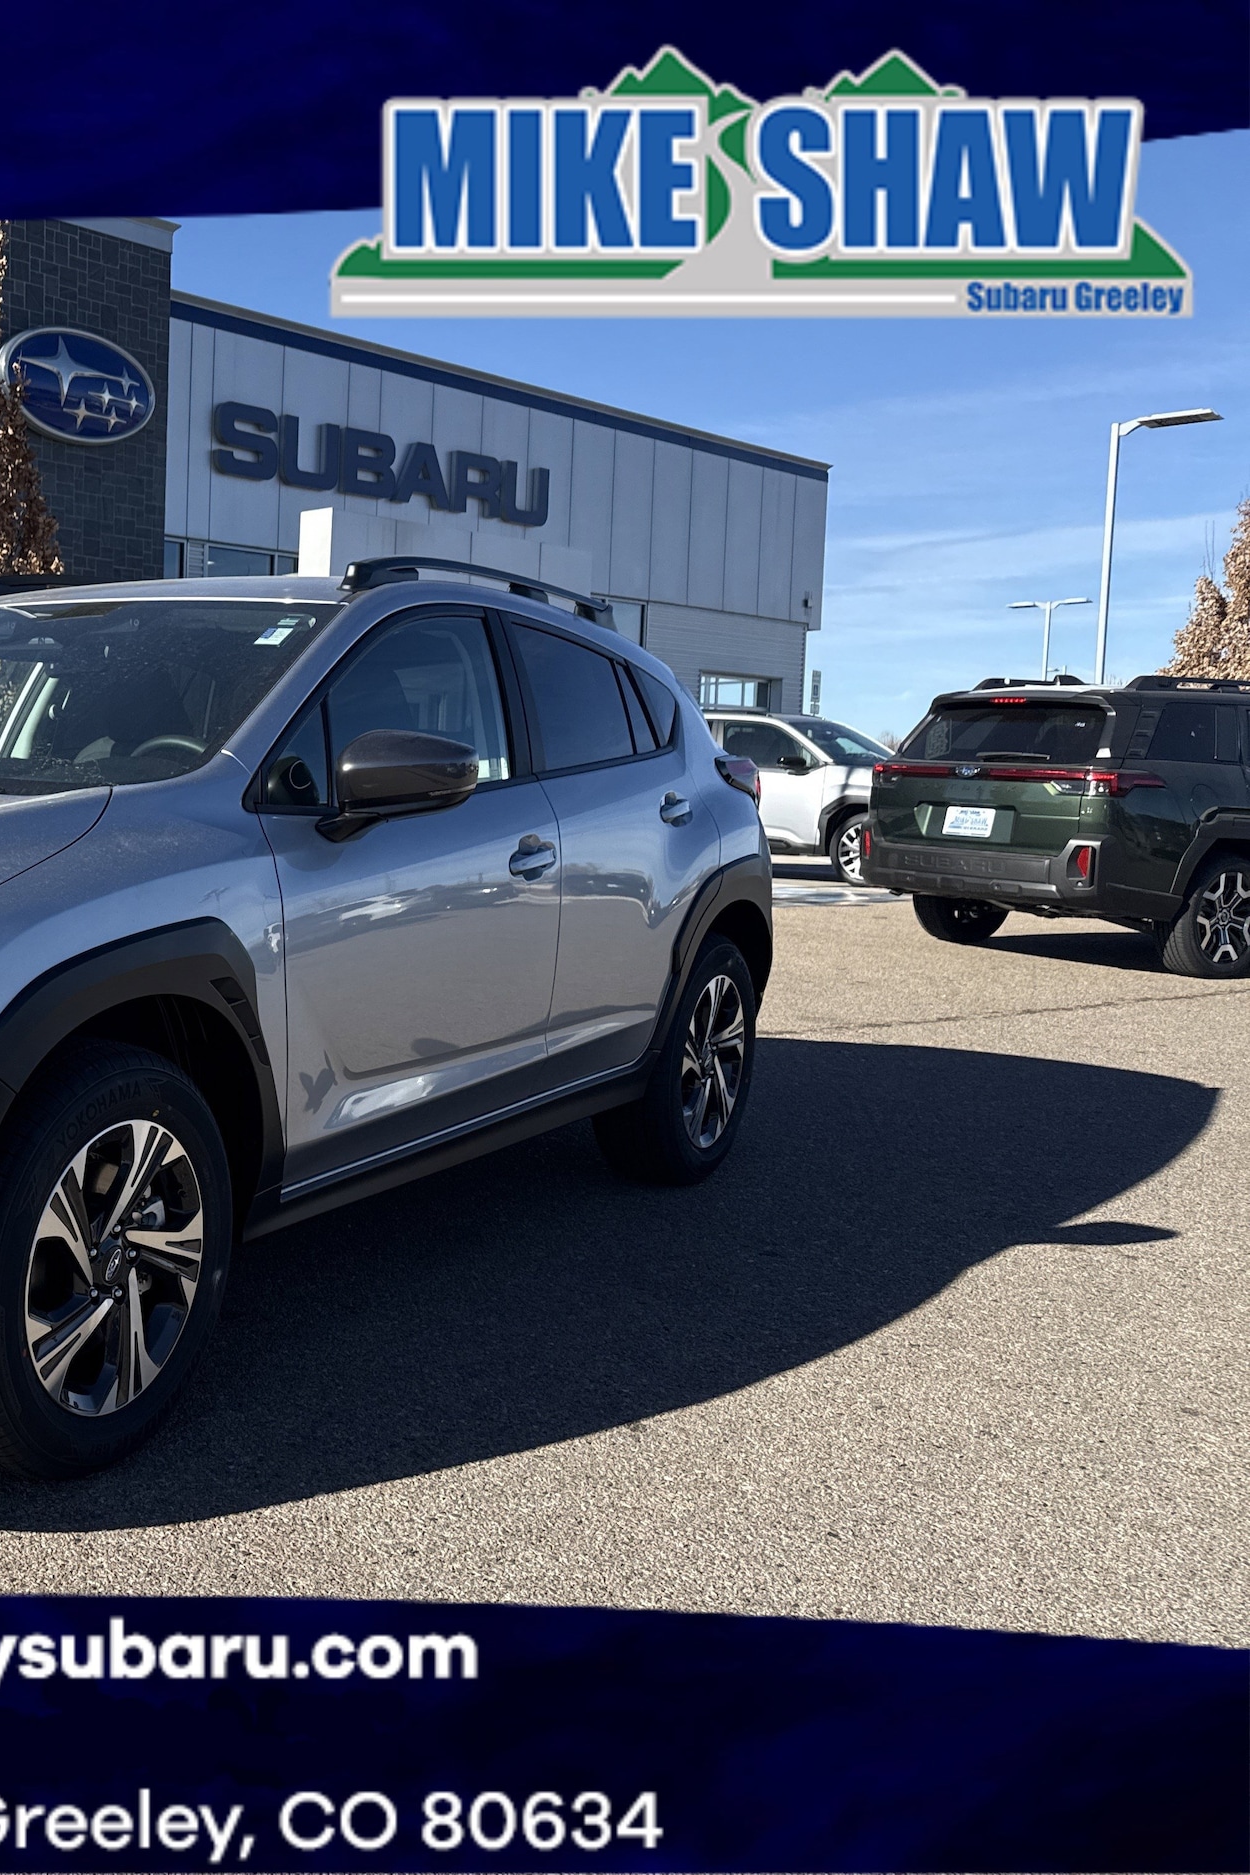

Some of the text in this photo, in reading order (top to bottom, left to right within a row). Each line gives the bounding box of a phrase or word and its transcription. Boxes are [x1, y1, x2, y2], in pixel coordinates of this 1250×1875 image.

[212, 401, 550, 527] SUBARU
[904, 854, 1007, 874] SUBARU
[56, 1080, 141, 1148] YOKOHAMA
